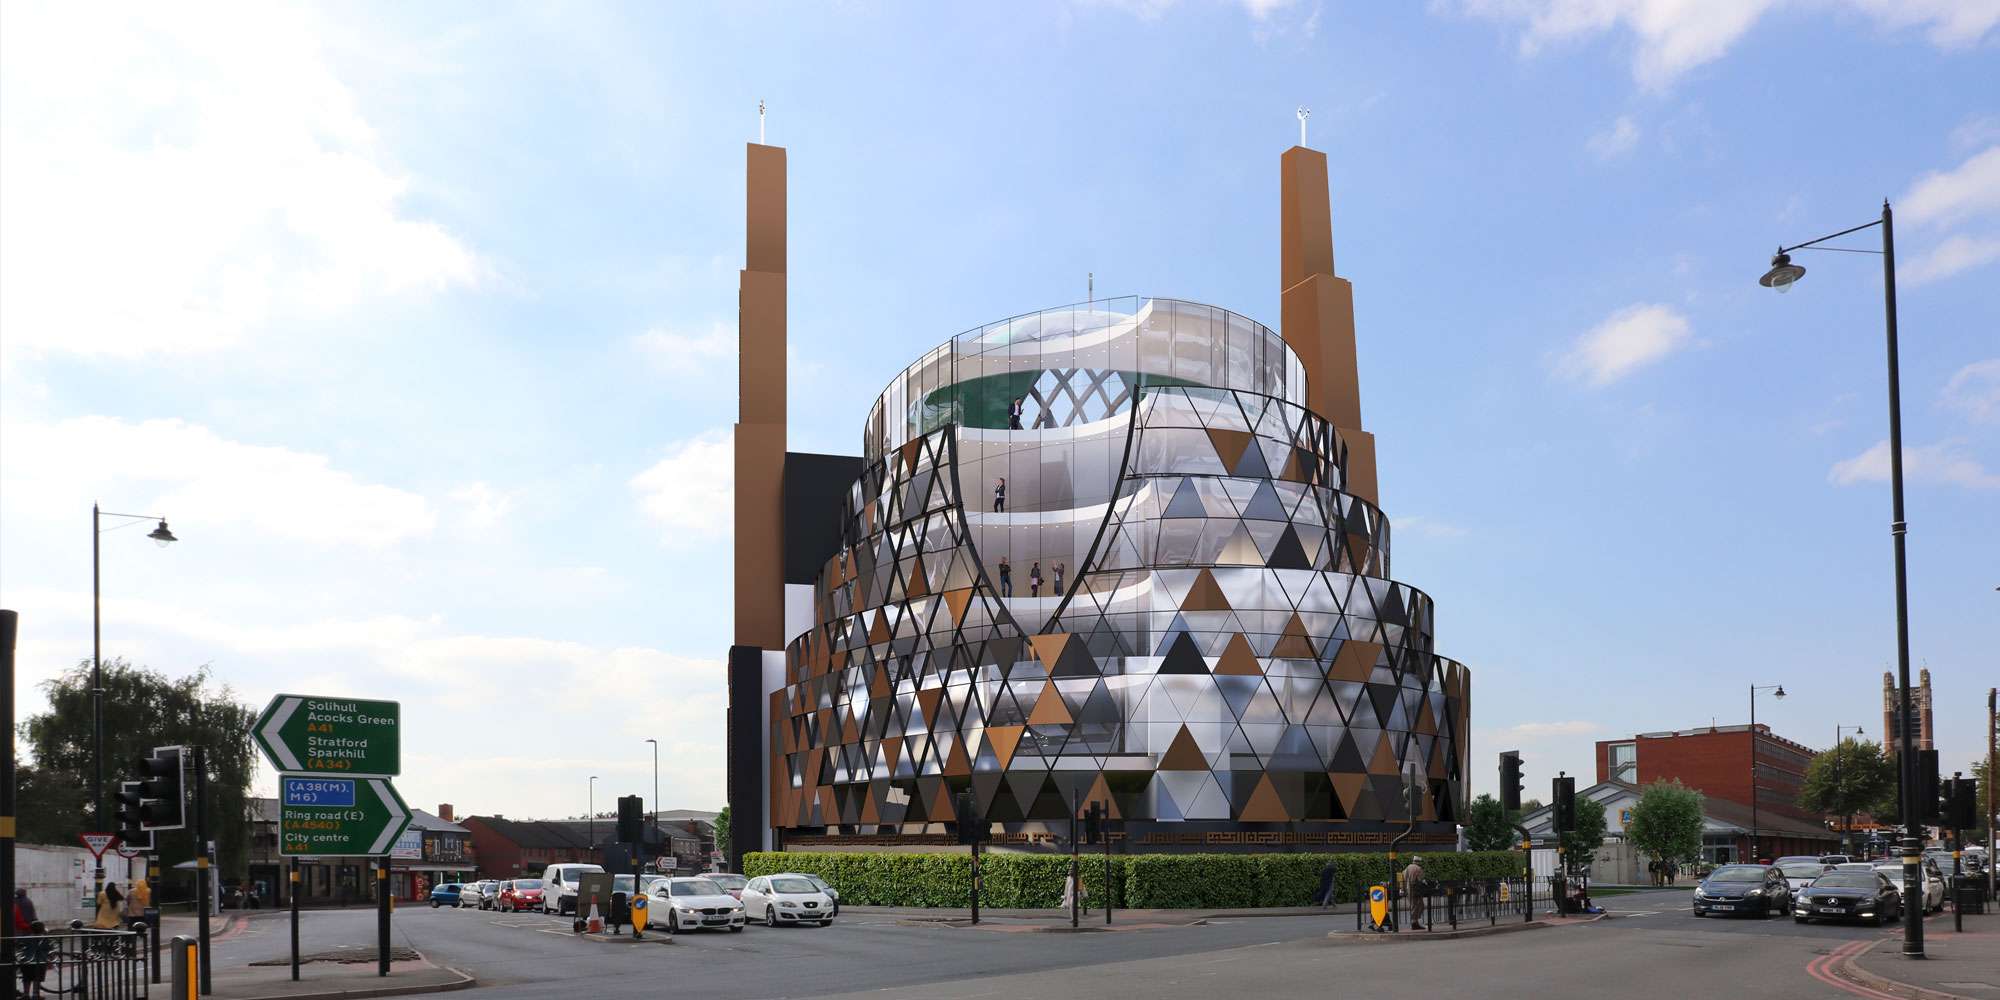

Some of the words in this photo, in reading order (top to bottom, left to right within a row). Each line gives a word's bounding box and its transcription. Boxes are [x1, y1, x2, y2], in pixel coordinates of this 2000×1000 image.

[308, 700, 357, 712] Solihull
[308, 712, 353, 723] Acocks
[358, 714, 395, 725] Green
[308, 736, 368, 748] Stratford
[308, 747, 366, 759] Sparkhill
[285, 810, 311, 821] Ring
[315, 811, 341, 820] road
[344, 810, 364, 821] (E)
[285, 832, 309, 843] City
[313, 833, 350, 842] centre
